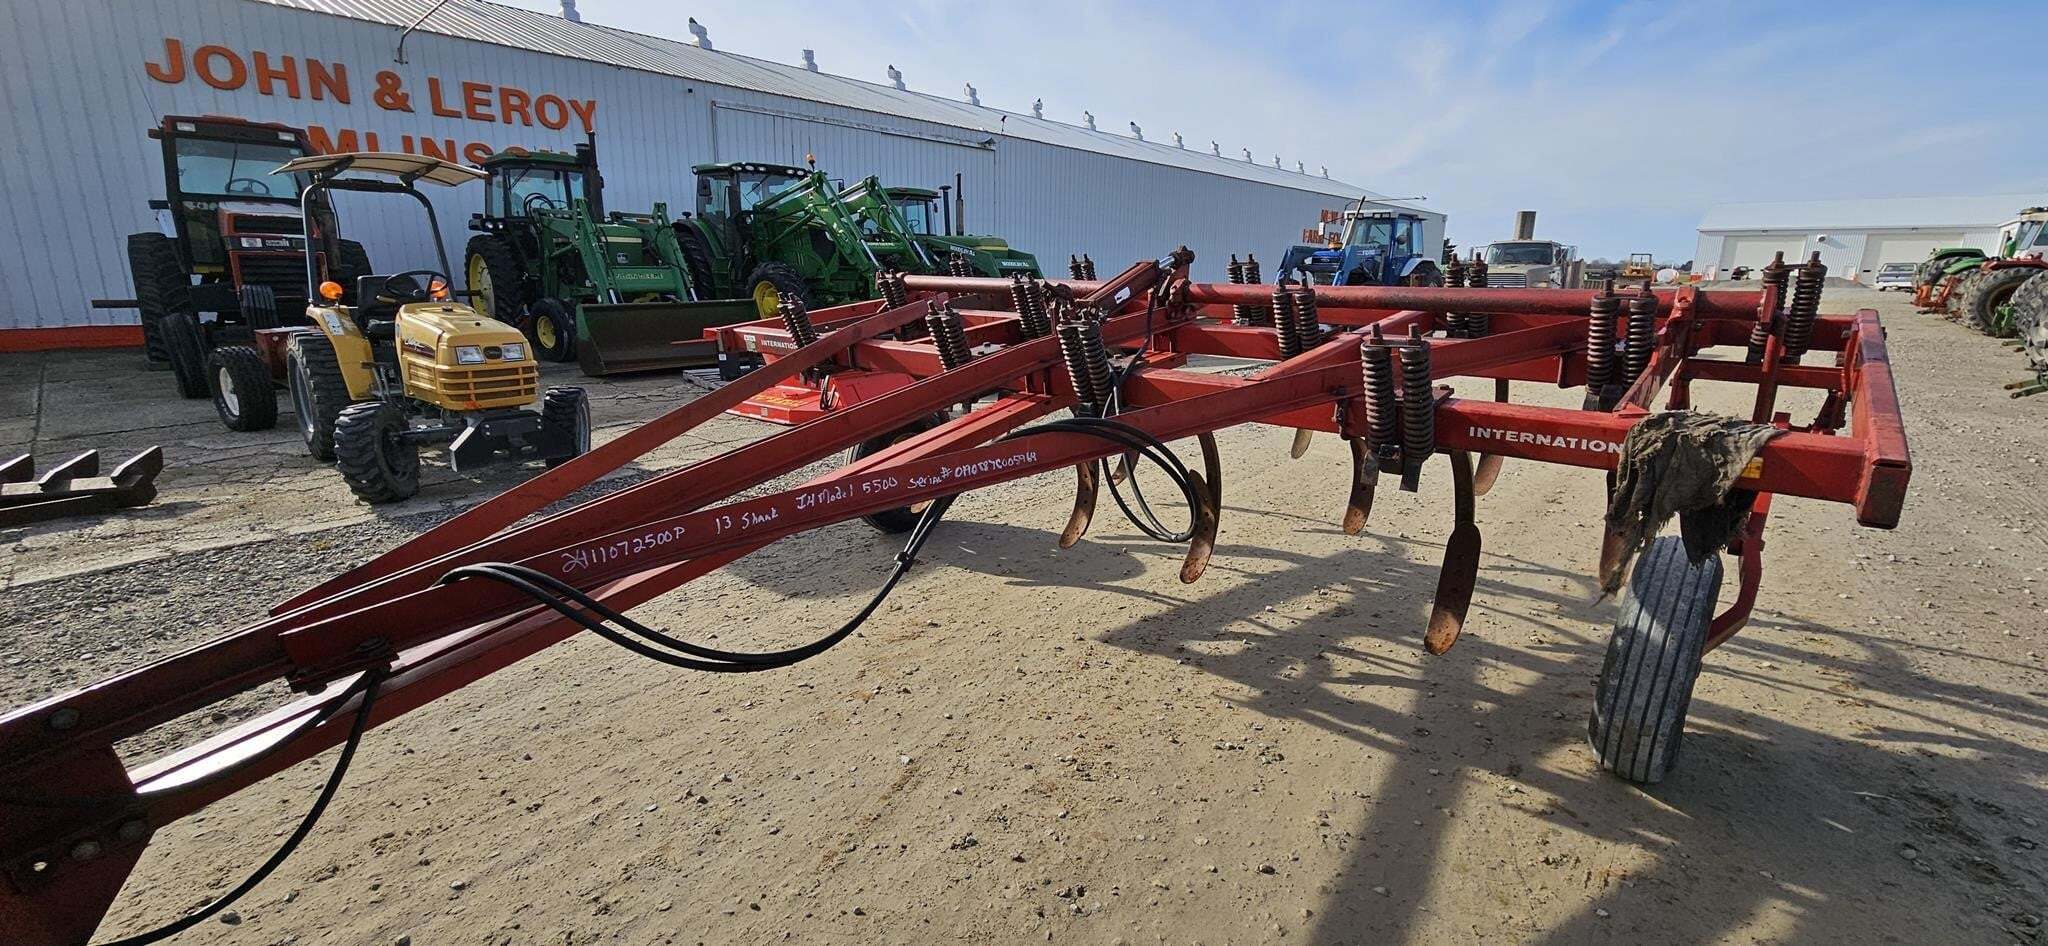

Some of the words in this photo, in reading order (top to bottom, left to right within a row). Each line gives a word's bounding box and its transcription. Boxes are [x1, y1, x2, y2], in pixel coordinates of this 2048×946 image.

[145, 37, 351, 105] JOHN
[373, 70, 415, 113] &
[427, 76, 597, 133] LEROY
[1469, 426, 1625, 454] INTERNATION
[716, 515, 732, 535] 13
